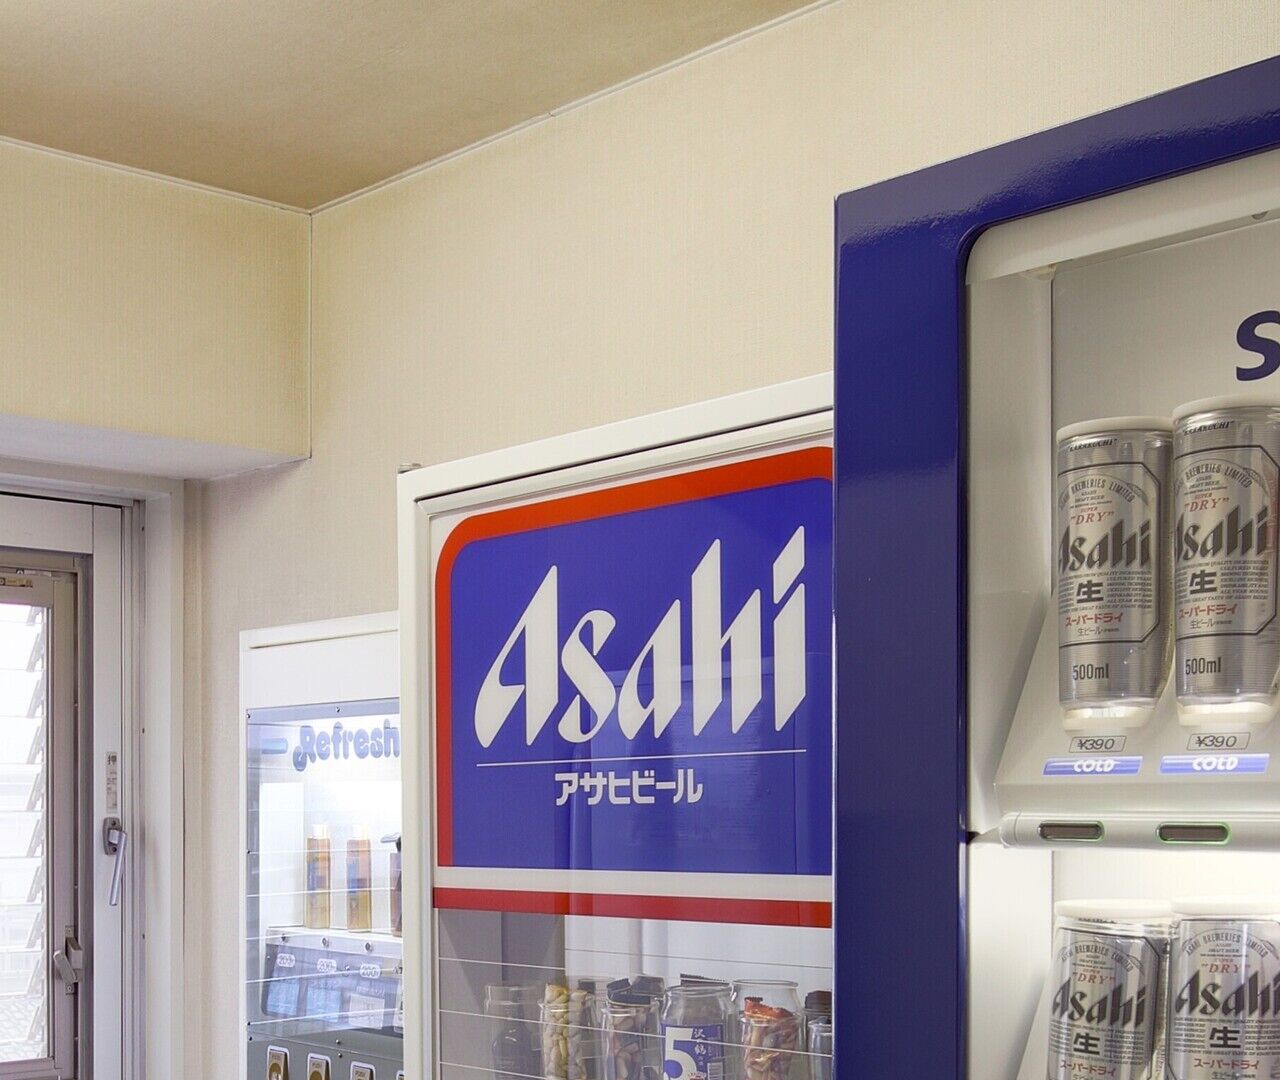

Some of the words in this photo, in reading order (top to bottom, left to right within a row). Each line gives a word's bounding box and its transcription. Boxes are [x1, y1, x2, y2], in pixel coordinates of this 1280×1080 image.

[1076, 579, 1104, 603] 生
[1189, 569, 1217, 595] 生
[1065, 612, 1123, 627] スーパードライ
[1179, 604, 1238, 619] スーパードライ
[475, 525, 807, 749] Asahi
[1072, 663, 1109, 681] 500ml
[1185, 657, 1222, 675] 500ml
[293, 718, 400, 772] Refresh
[1077, 737, 1116, 751] ¥390
[1195, 735, 1237, 748] ¥390
[1073, 757, 1118, 774] COLD
[1191, 755, 1239, 772] COLD
[555, 768, 704, 806] アサヒビール
[1052, 976, 1147, 1029] Asahi
[1073, 1032, 1100, 1056] 生
[1209, 1026, 1242, 1049] 生
[1060, 1058, 1117, 1077] スーパードライ
[1194, 1058, 1260, 1070] スーパードライ
